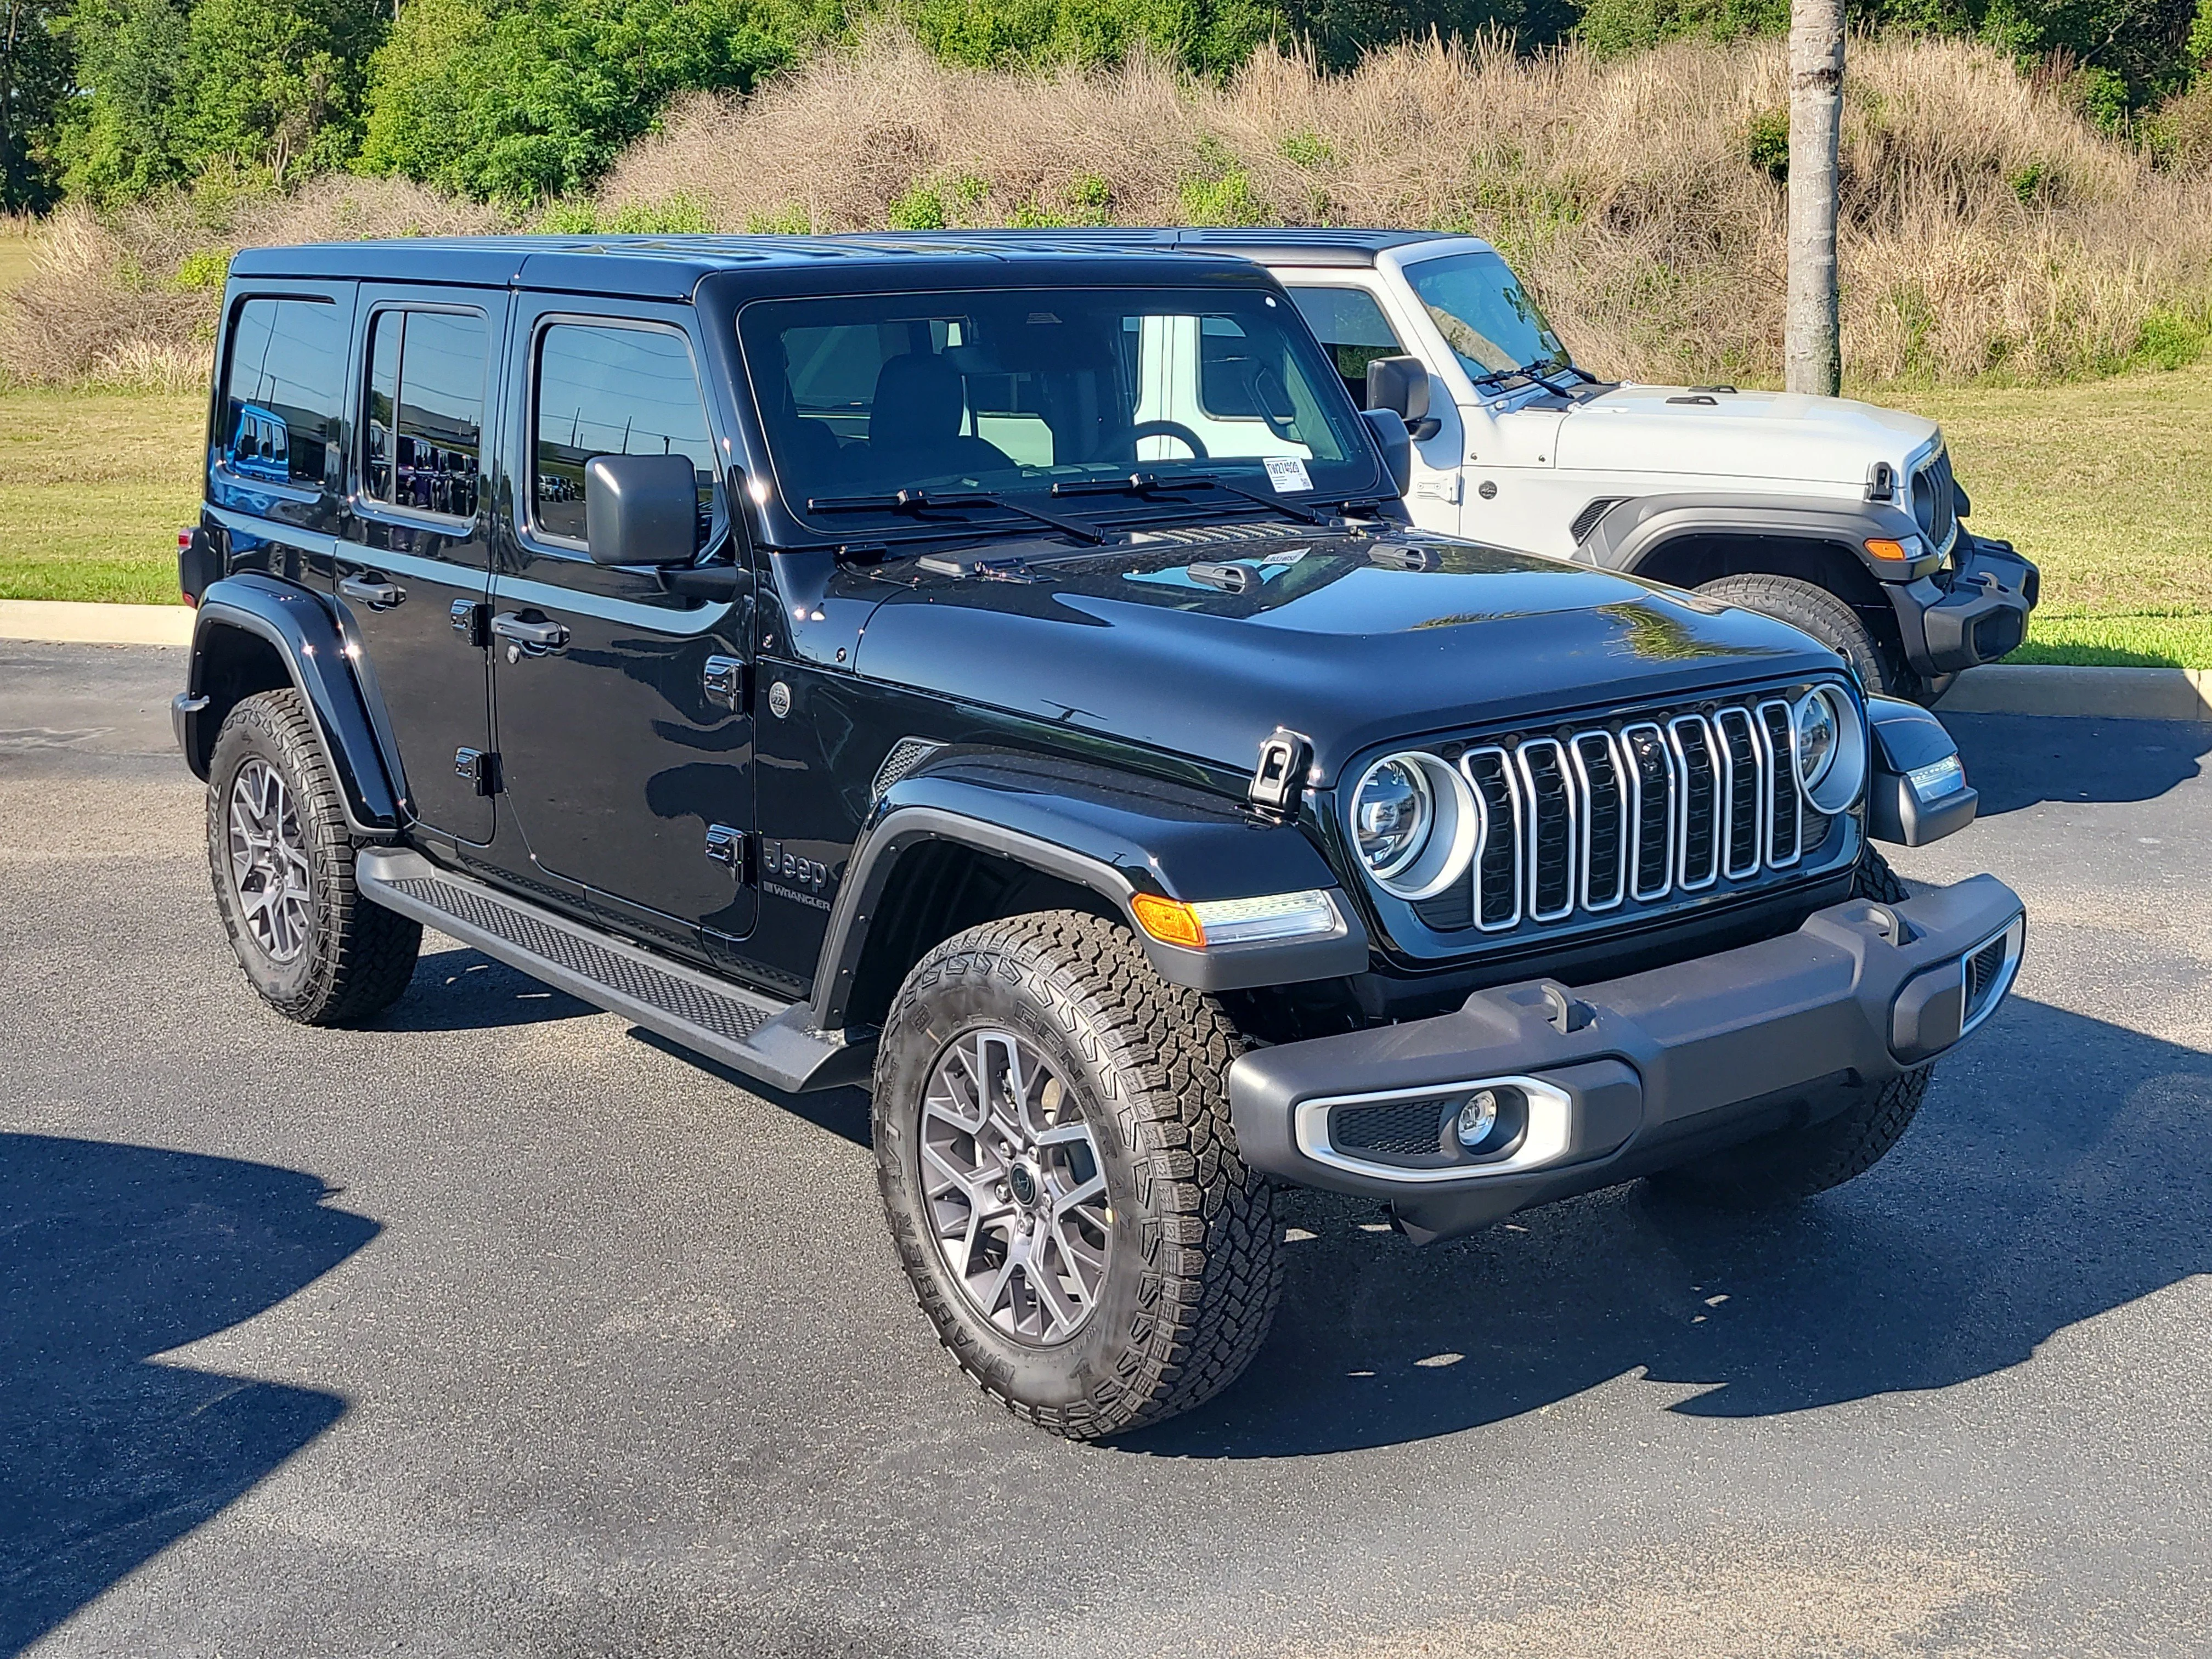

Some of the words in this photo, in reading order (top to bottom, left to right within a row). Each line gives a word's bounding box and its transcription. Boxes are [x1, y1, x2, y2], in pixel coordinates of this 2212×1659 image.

[764, 841, 827, 893] Jeep
[772, 884, 831, 912] WRANGLER
[1014, 1000, 1130, 1237] GENERAL
[894, 1211, 1015, 1386] GRABBER
